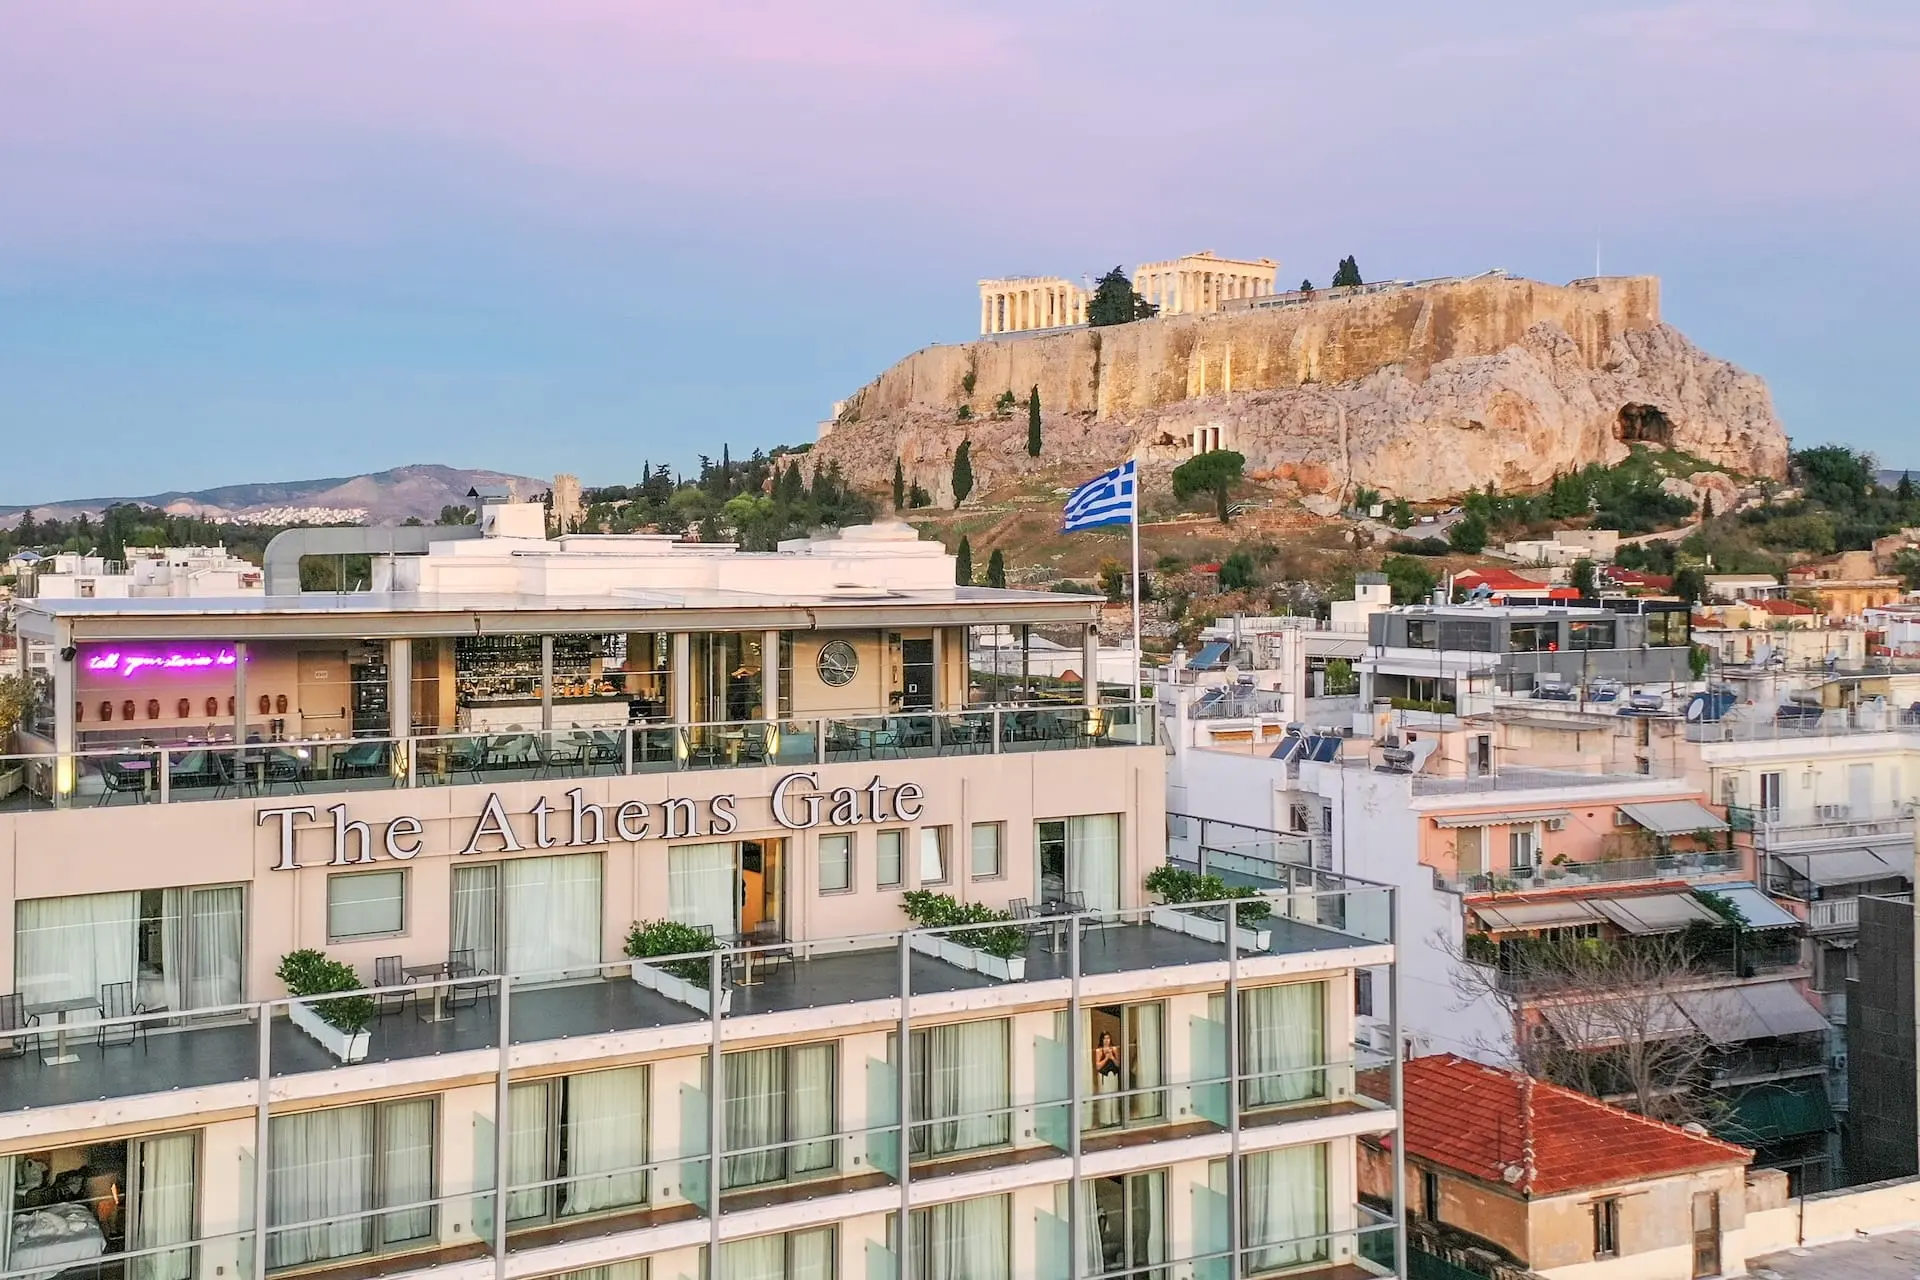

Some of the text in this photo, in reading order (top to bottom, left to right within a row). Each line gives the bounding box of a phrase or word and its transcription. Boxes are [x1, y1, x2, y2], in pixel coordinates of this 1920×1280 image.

[257, 771, 925, 871] The Athens Gate
